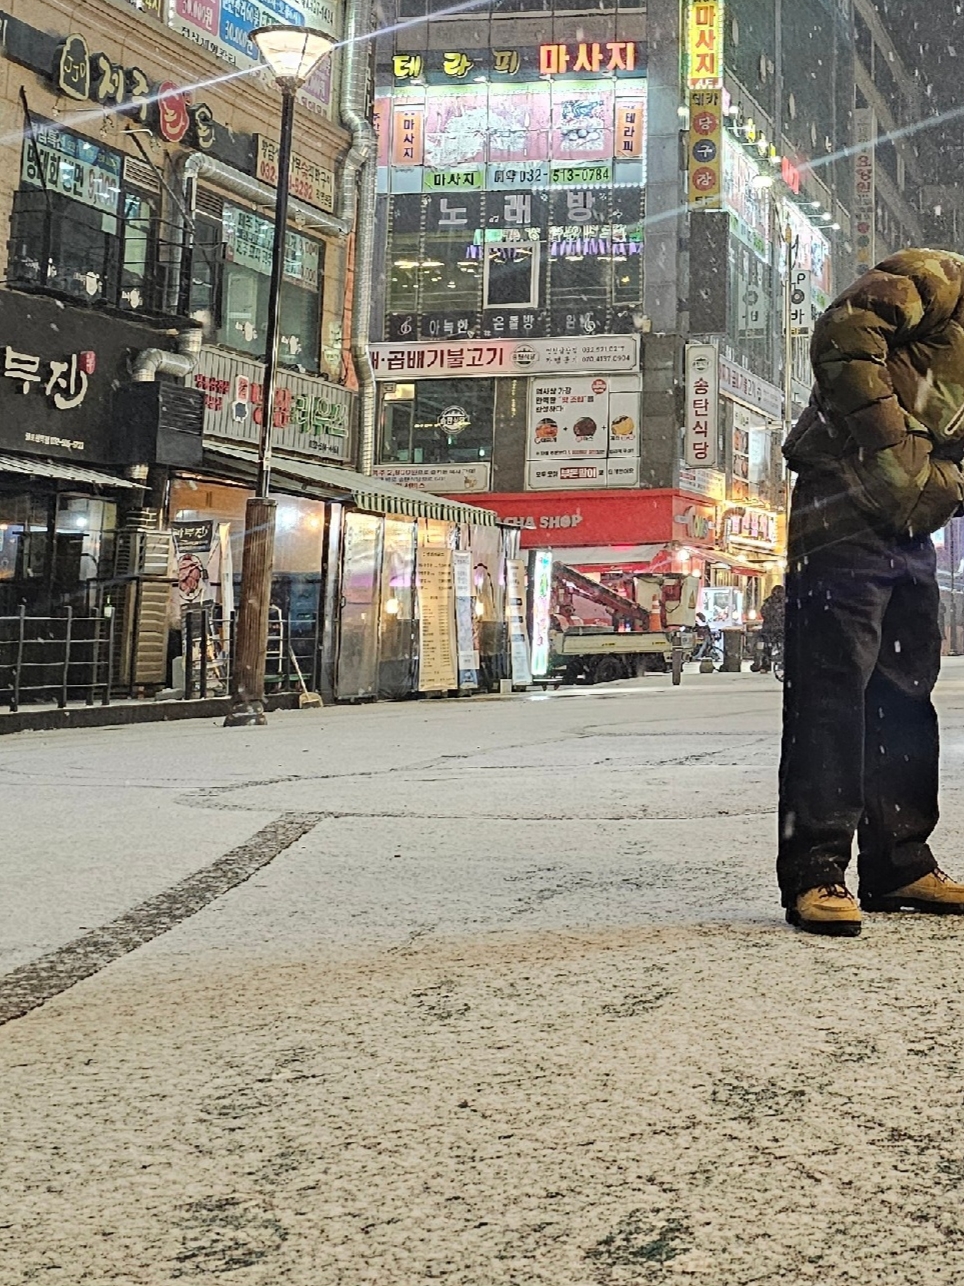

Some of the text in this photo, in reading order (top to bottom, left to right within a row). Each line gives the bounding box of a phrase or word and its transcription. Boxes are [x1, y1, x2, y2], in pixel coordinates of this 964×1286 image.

[695, 5, 717, 75] 마사지
[63, 56, 87, 83] JJD
[392, 42, 637, 78] 테라피 마사지
[402, 118, 416, 159] 마사지
[623, 111, 637, 152] 테라피
[697, 117, 714, 187] 당구장
[432, 172, 475, 187] 마사지
[437, 191, 595, 226] 노래방
[692, 377, 711, 461] 송탄식당
[539, 513, 583, 529] SHOP
